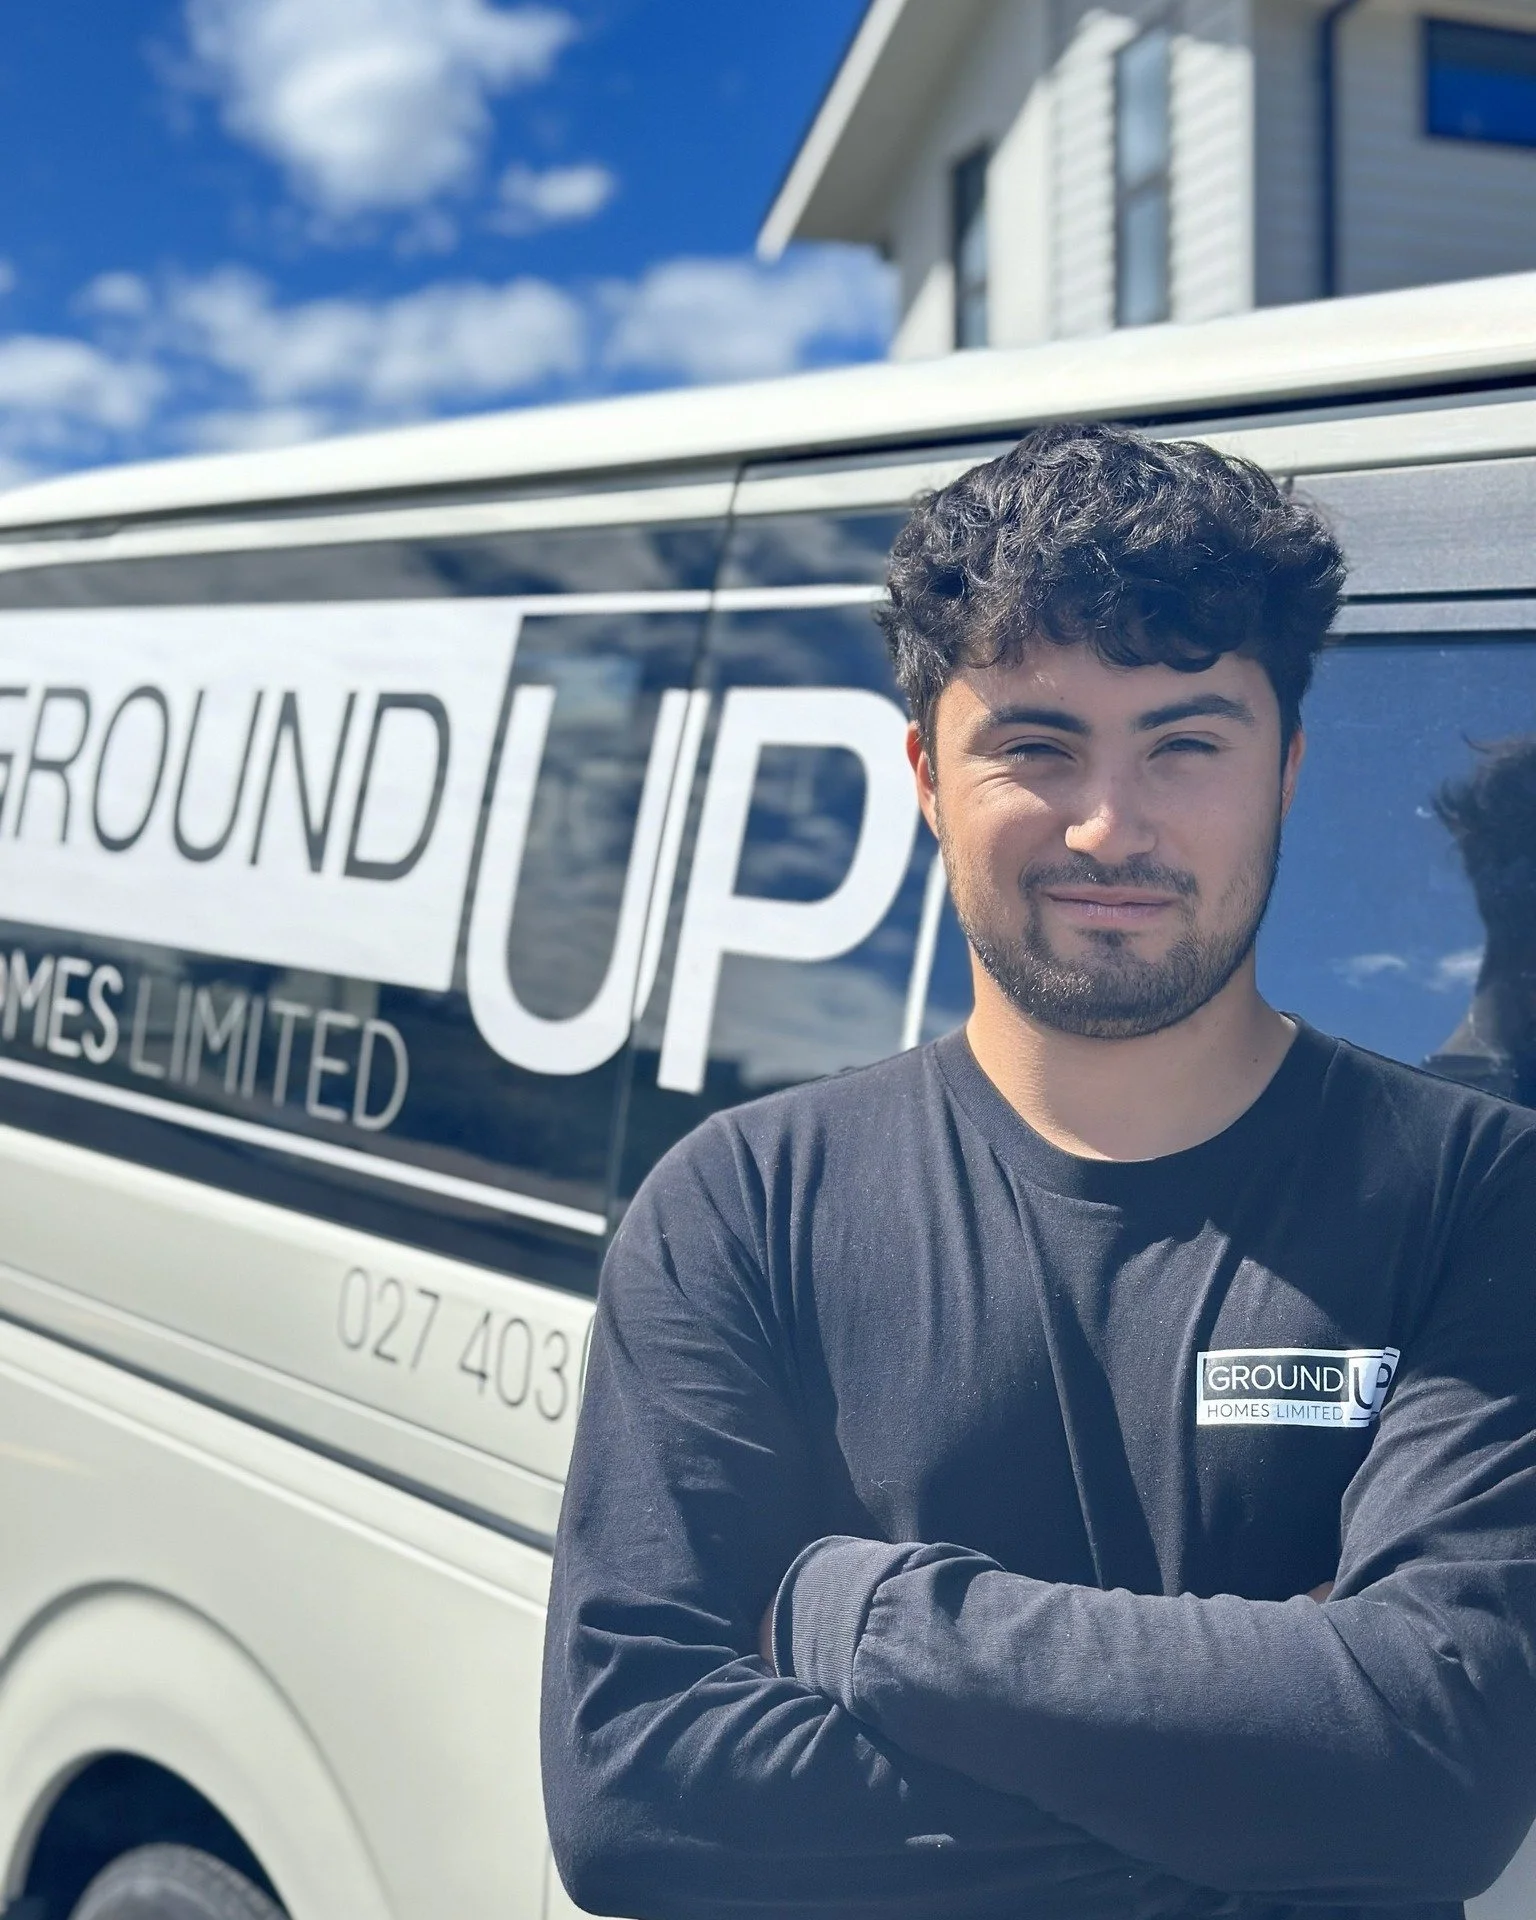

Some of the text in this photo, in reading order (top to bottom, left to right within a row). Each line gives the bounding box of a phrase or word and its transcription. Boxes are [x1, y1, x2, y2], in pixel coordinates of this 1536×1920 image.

[466, 683, 920, 1094] UP
[0, 948, 409, 1131] MES LIMITED
[337, 1265, 571, 1421] 027 403
[1207, 1403, 1344, 1420] HOMES LIMITED
[1208, 1364, 1344, 1392] GROUND
